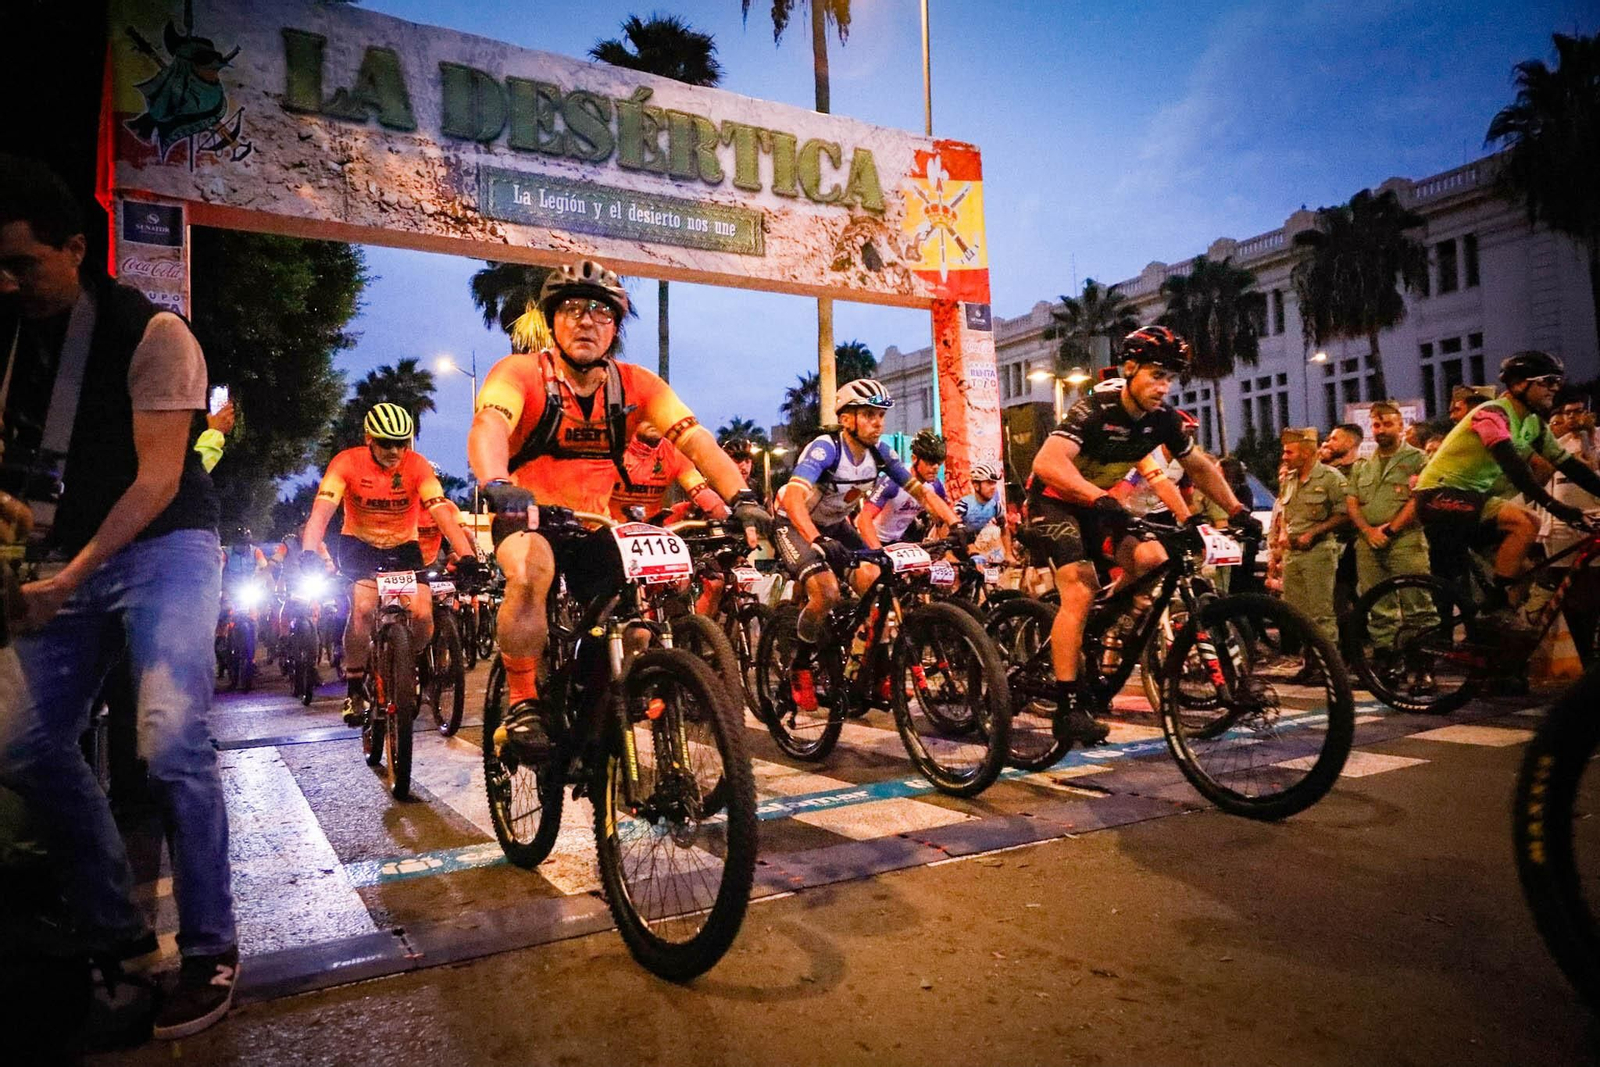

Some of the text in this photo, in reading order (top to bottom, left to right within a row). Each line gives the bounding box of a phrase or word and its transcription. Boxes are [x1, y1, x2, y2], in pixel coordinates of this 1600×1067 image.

[280, 26, 886, 214] LA DESÉRTICA
[513, 184, 736, 237] La Legión y el desierto nos une
[148, 291, 181, 302] UPO
[631, 537, 680, 556] 4118
[896, 548, 923, 559] 4177
[384, 575, 413, 584] 4898
